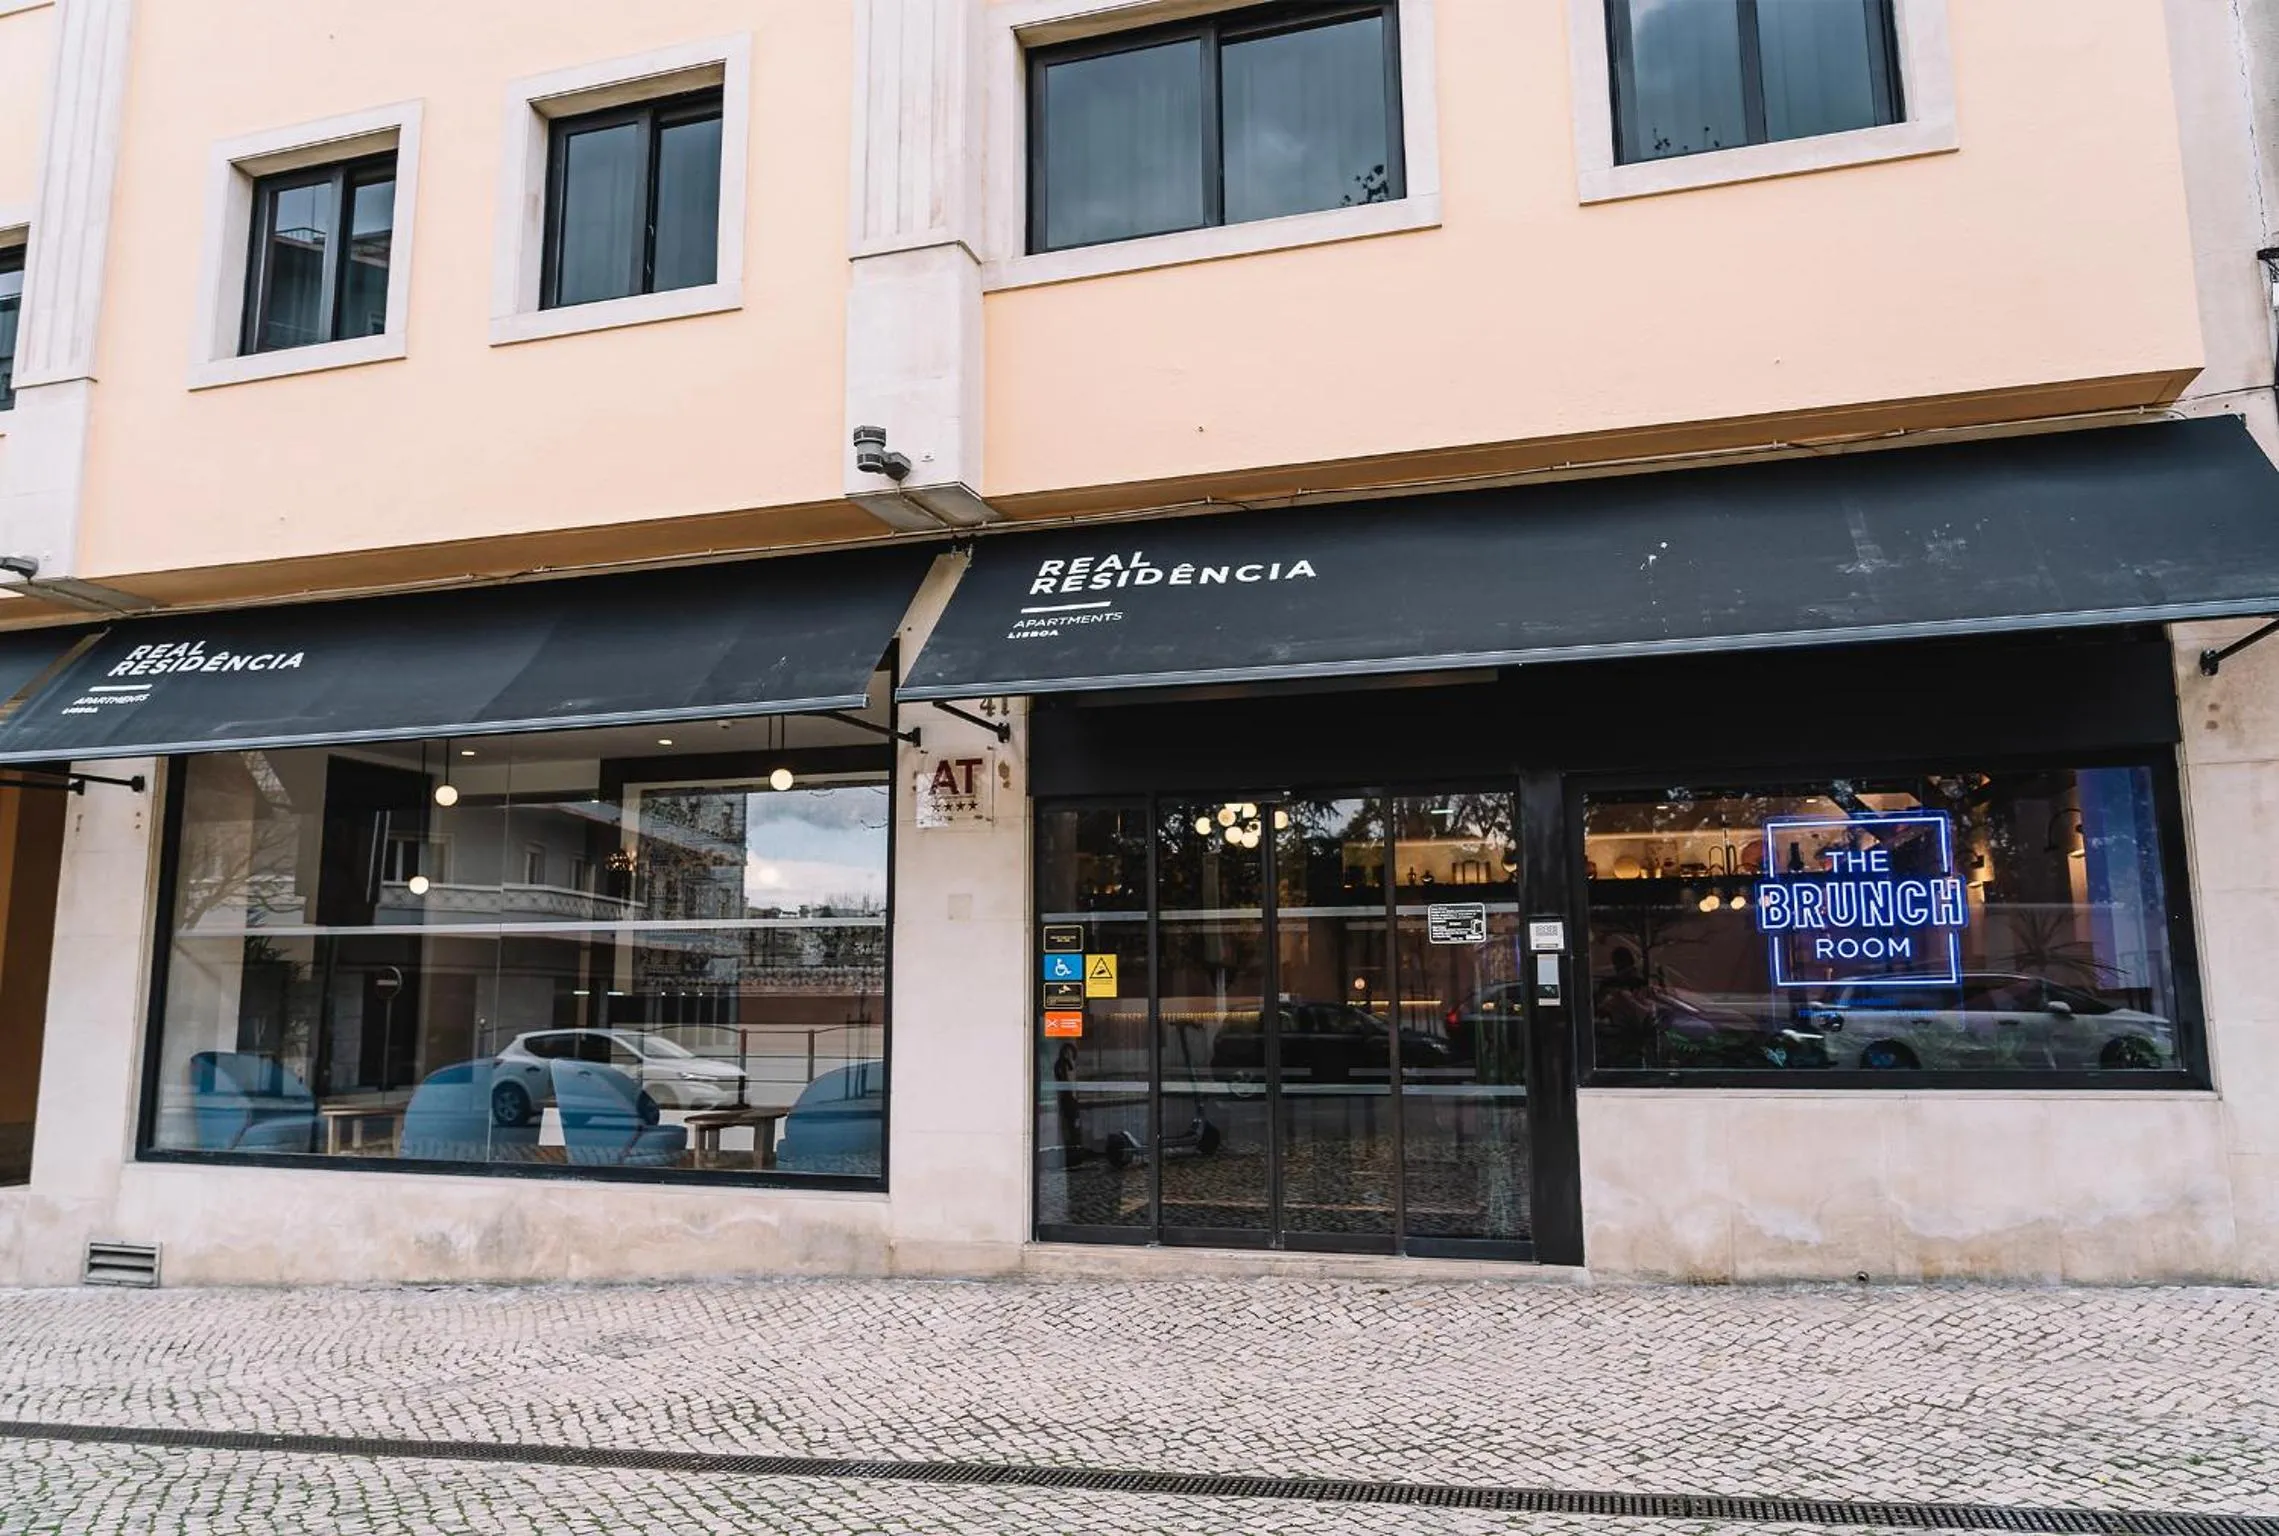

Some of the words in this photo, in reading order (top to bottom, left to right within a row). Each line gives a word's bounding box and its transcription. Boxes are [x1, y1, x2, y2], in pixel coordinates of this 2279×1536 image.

[1038, 551, 1151, 578] REAL
[1029, 559, 1318, 595] RESIDÊNCIA
[1012, 611, 1124, 629] APARTMENTS
[1006, 629, 1059, 639] LISBOA
[125, 641, 206, 661] REAL
[108, 651, 304, 677] RESIDÊNCIA
[928, 758, 983, 795] AT
[1825, 850, 1890, 873] THE
[1760, 879, 1963, 929] BRUNCH
[1815, 937, 1911, 959] ROOM
